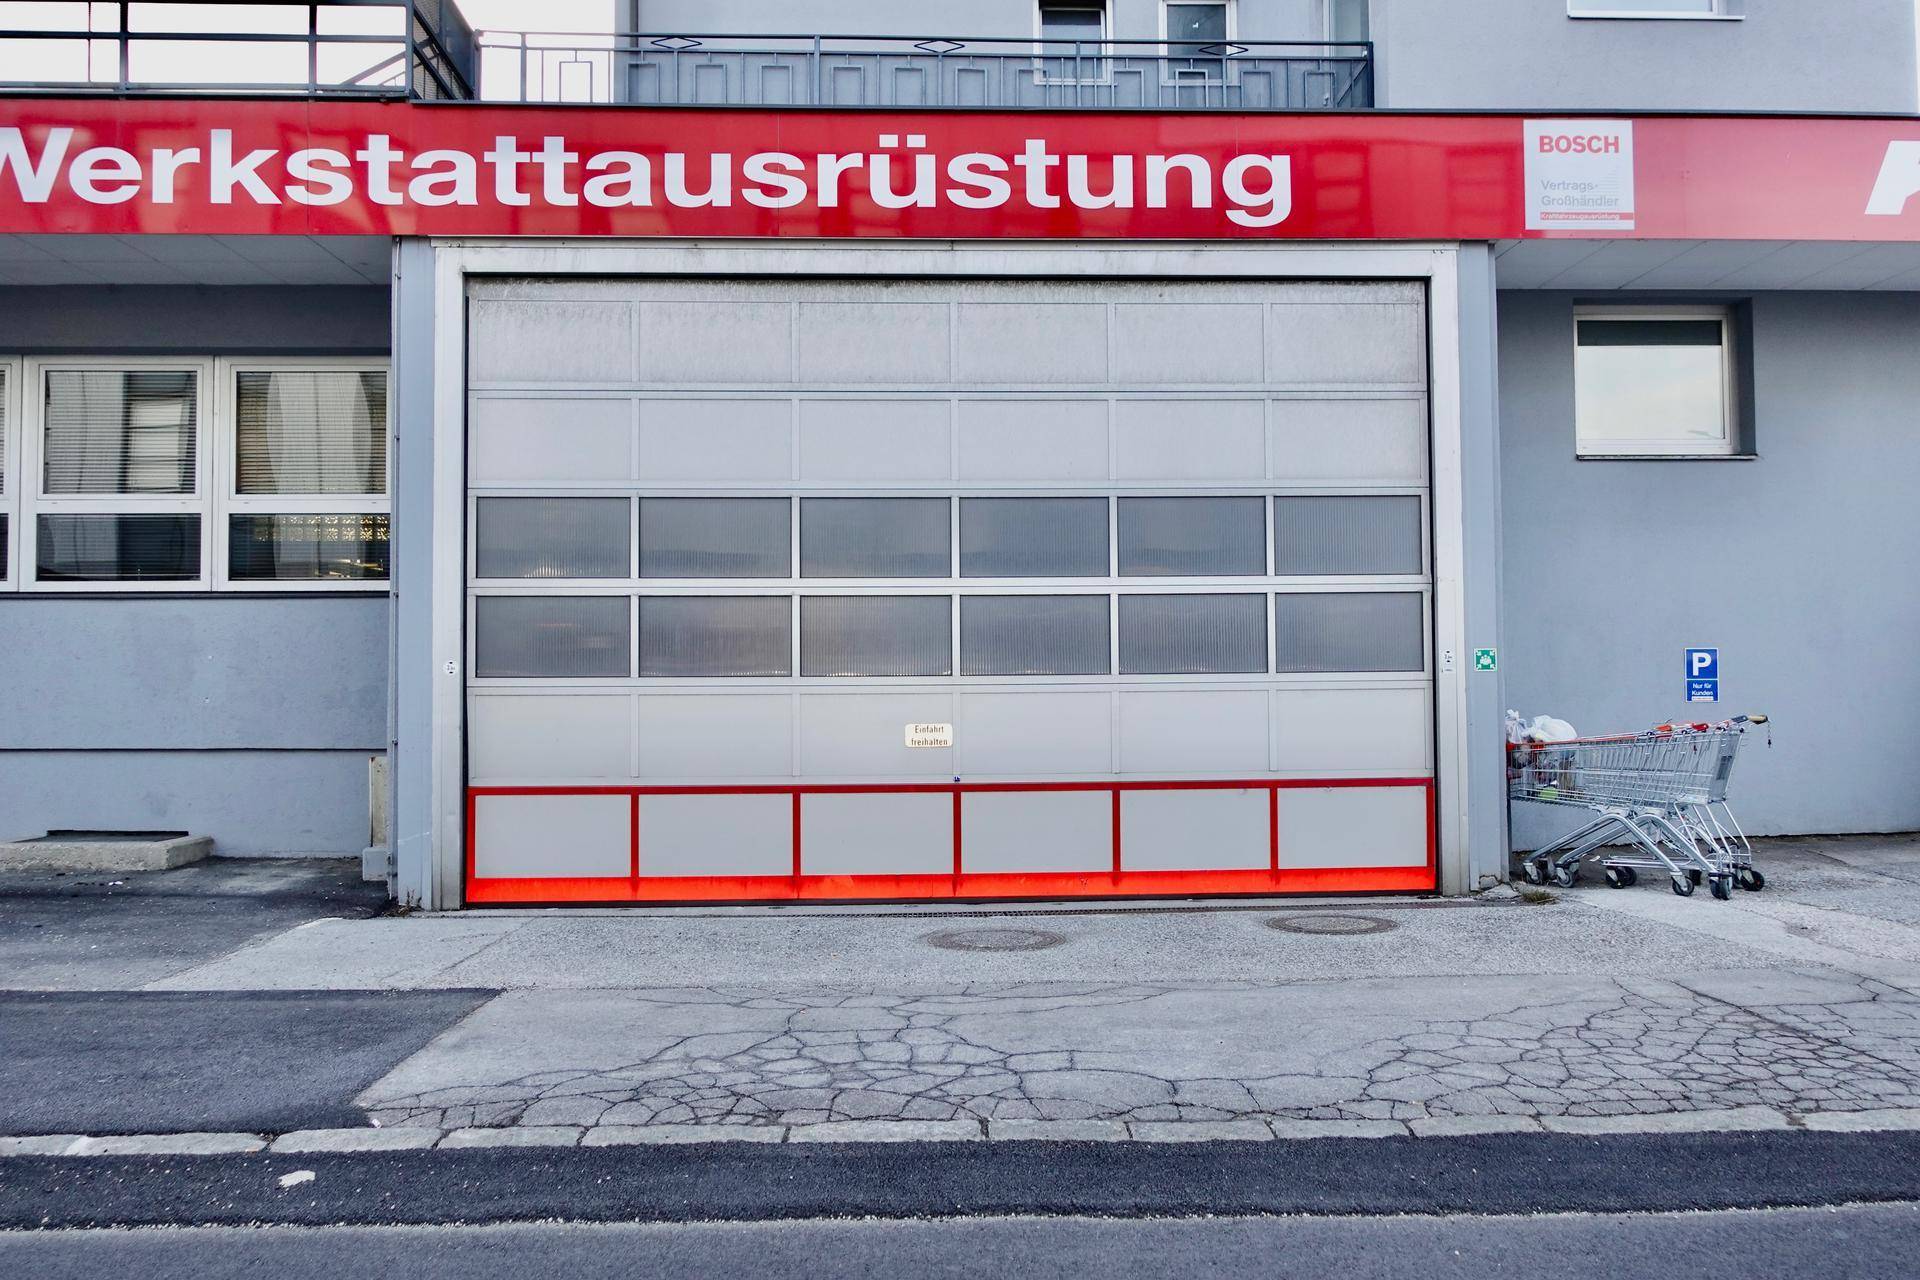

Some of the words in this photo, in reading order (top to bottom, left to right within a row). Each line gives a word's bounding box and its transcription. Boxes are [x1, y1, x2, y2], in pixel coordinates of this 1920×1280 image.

[1539, 134, 1620, 154] BOSCH
[1540, 180, 1599, 193] Vertrags-
[1541, 195, 1620, 208] Großhändler
[1692, 652, 1712, 676] P
[914, 724, 944, 734] Einfahrt
[911, 737, 948, 746] freihalten
